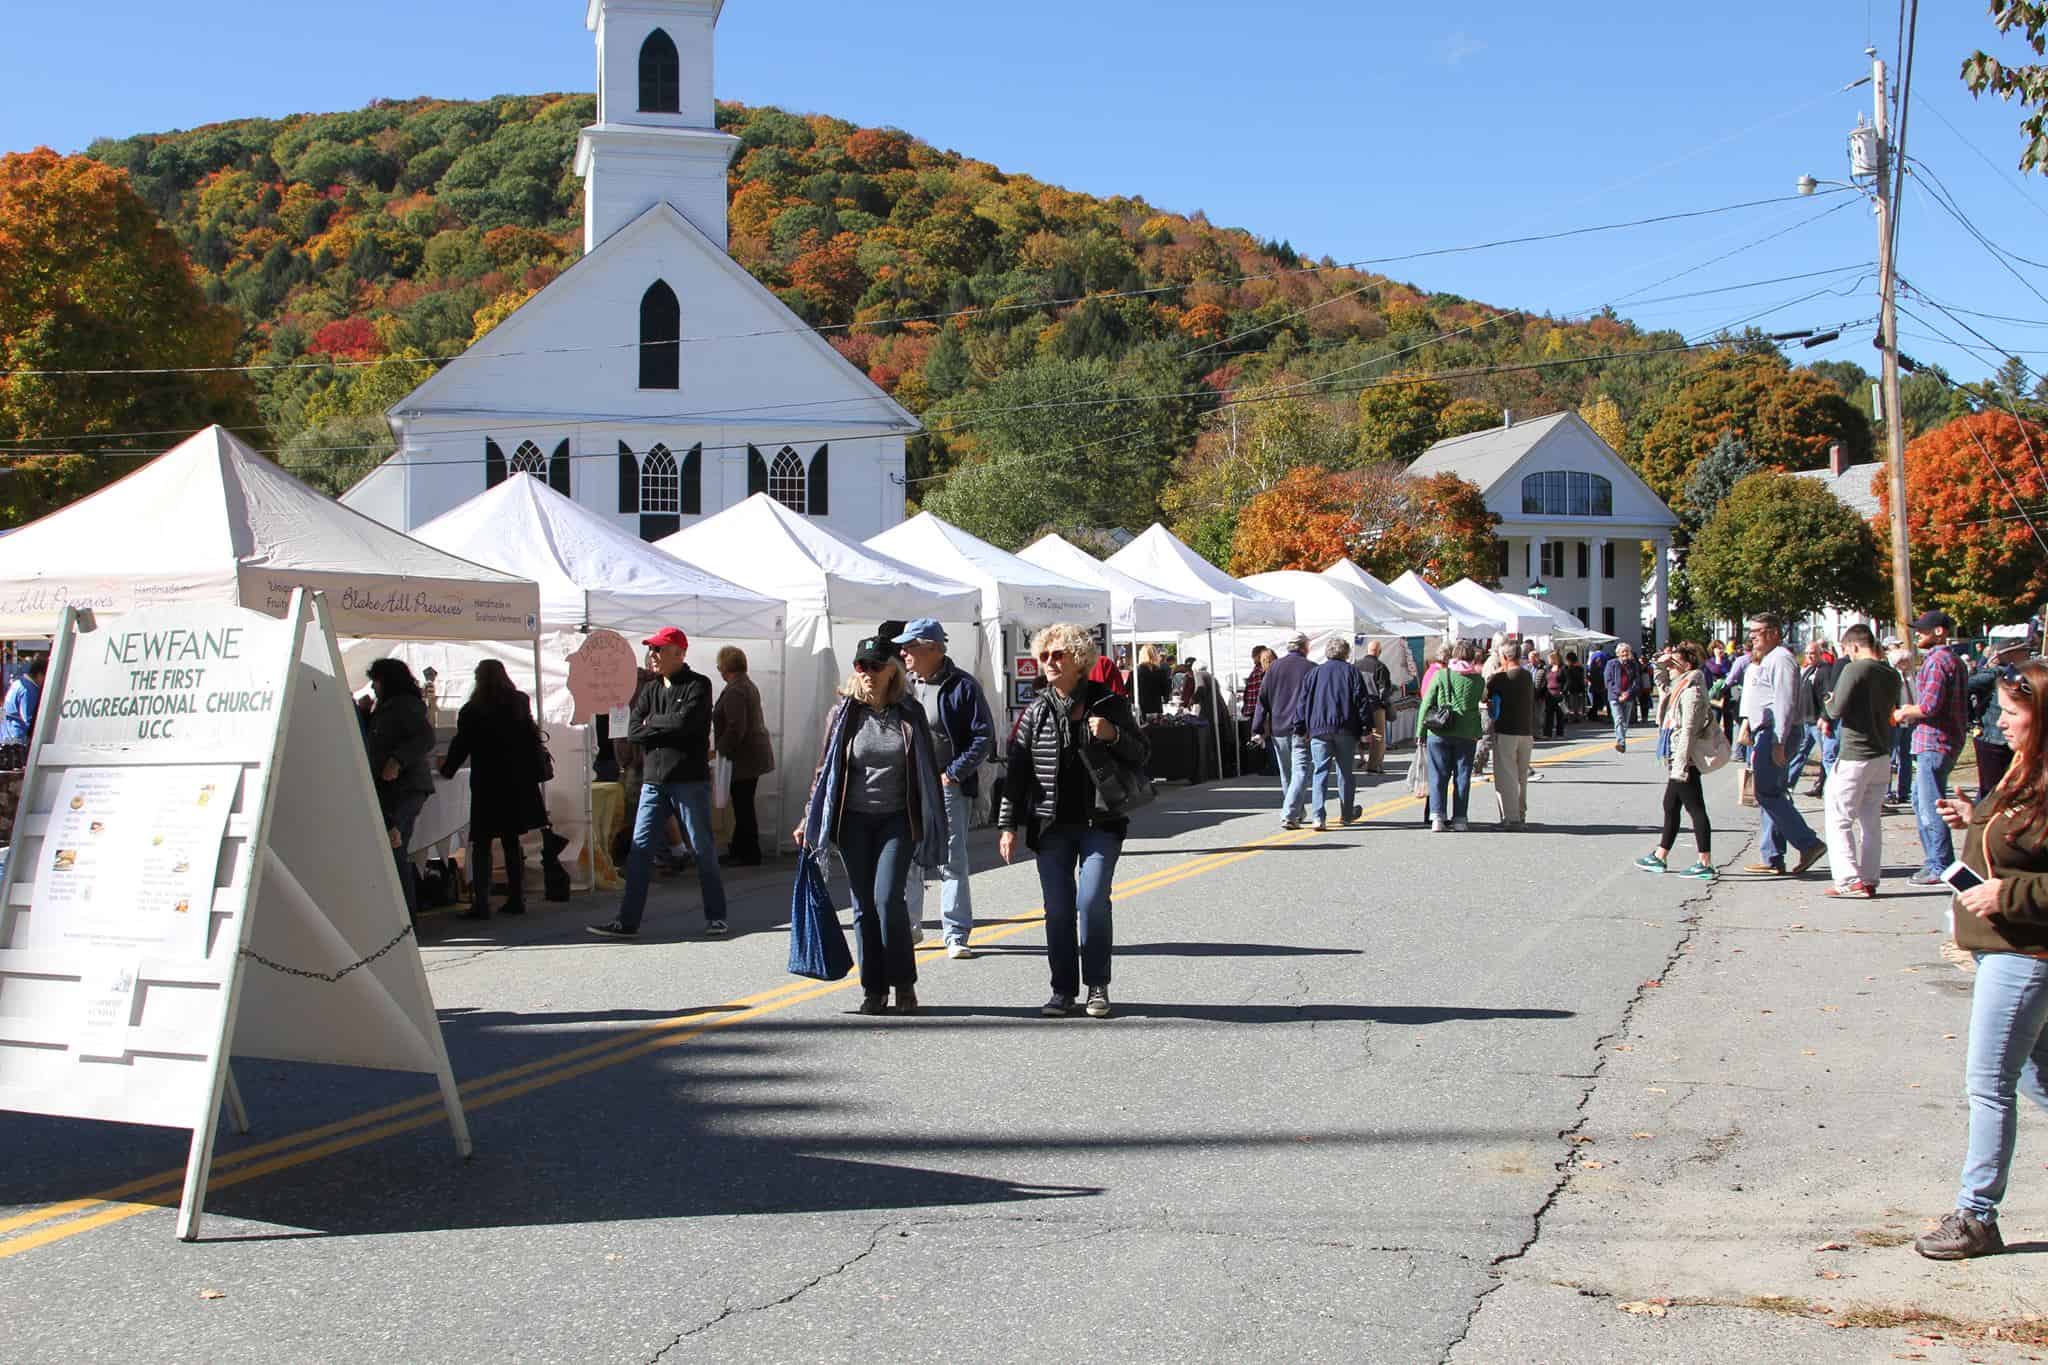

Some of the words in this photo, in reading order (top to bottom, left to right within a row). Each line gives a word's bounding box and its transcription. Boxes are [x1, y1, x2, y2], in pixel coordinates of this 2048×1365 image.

[343, 586, 378, 610] Blake
[380, 590, 412, 612] Hill
[414, 591, 463, 616] Preserves
[104, 628, 243, 664] NEWFANE
[130, 670, 159, 690] THE
[161, 668, 205, 690] FIRST
[60, 693, 197, 719] CONGREGATIONAL
[205, 691, 273, 713] CHURCH
